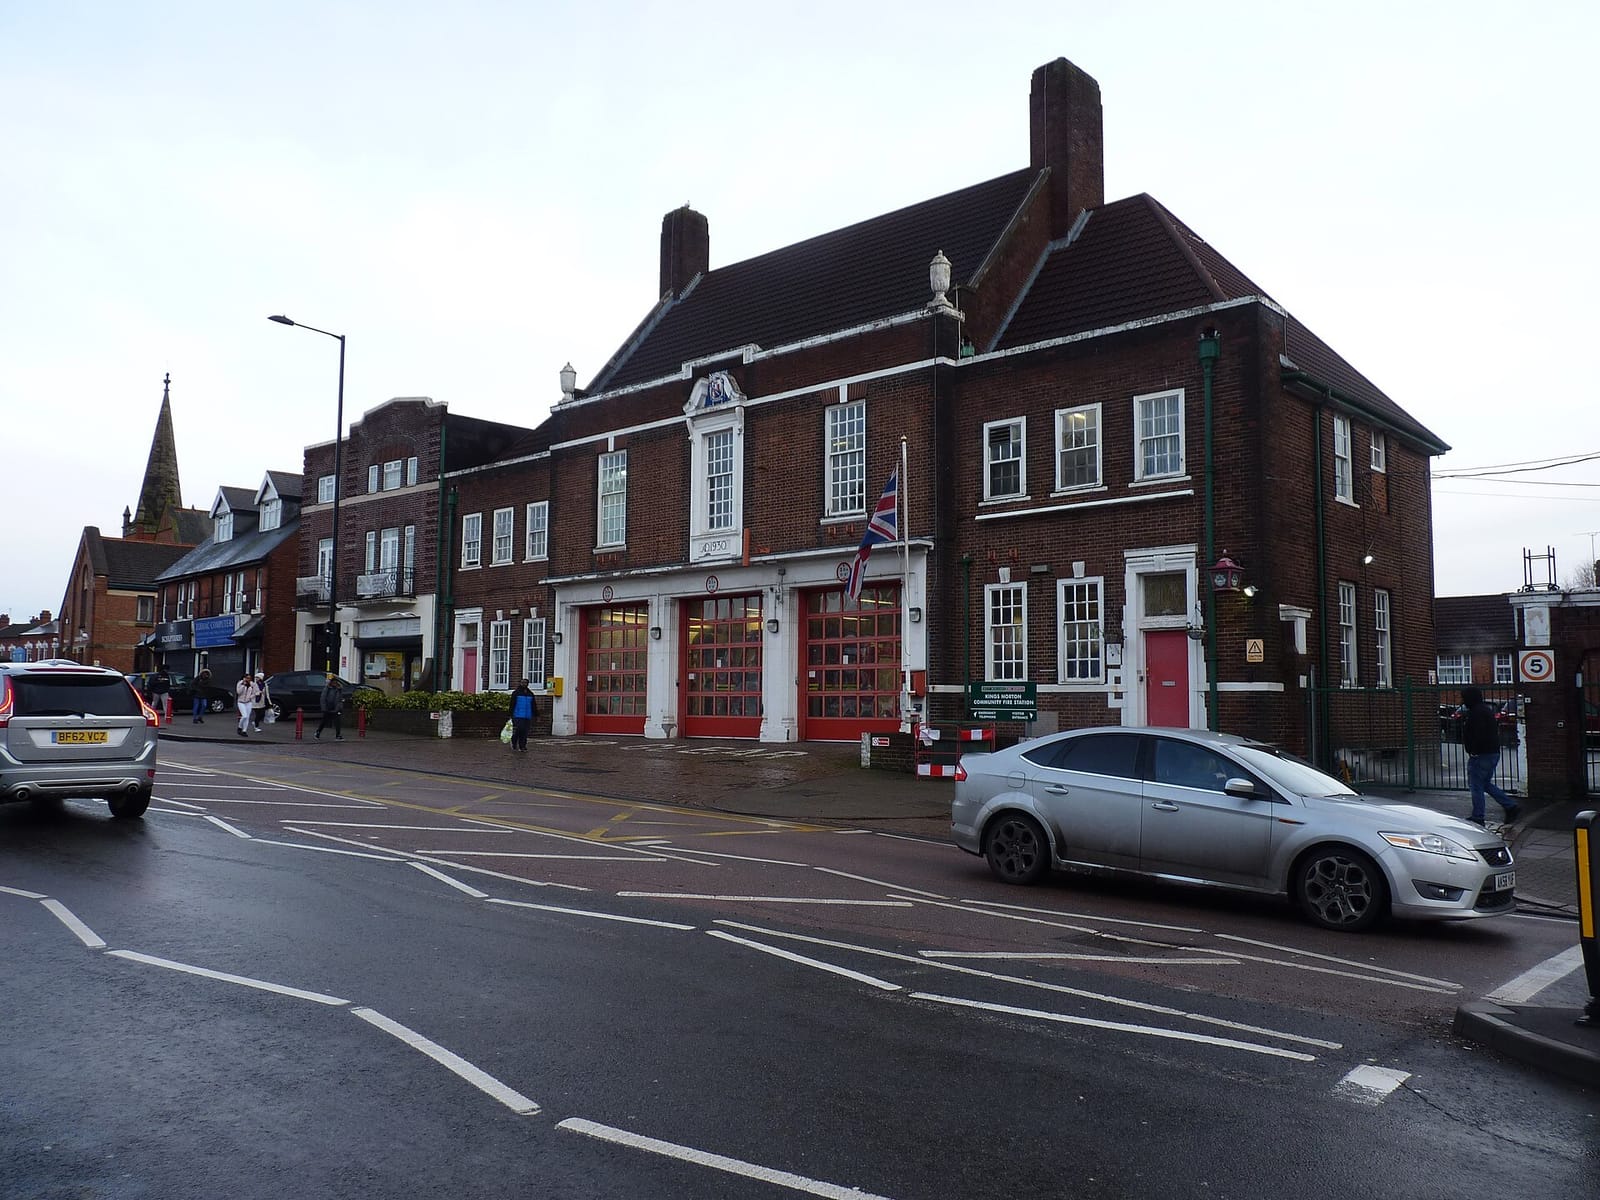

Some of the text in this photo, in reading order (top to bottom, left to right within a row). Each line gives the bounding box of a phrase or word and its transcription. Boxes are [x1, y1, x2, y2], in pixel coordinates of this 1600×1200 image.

[1530, 659, 1543, 673] 5
[59, 732, 106, 741] BF62 VCZ
